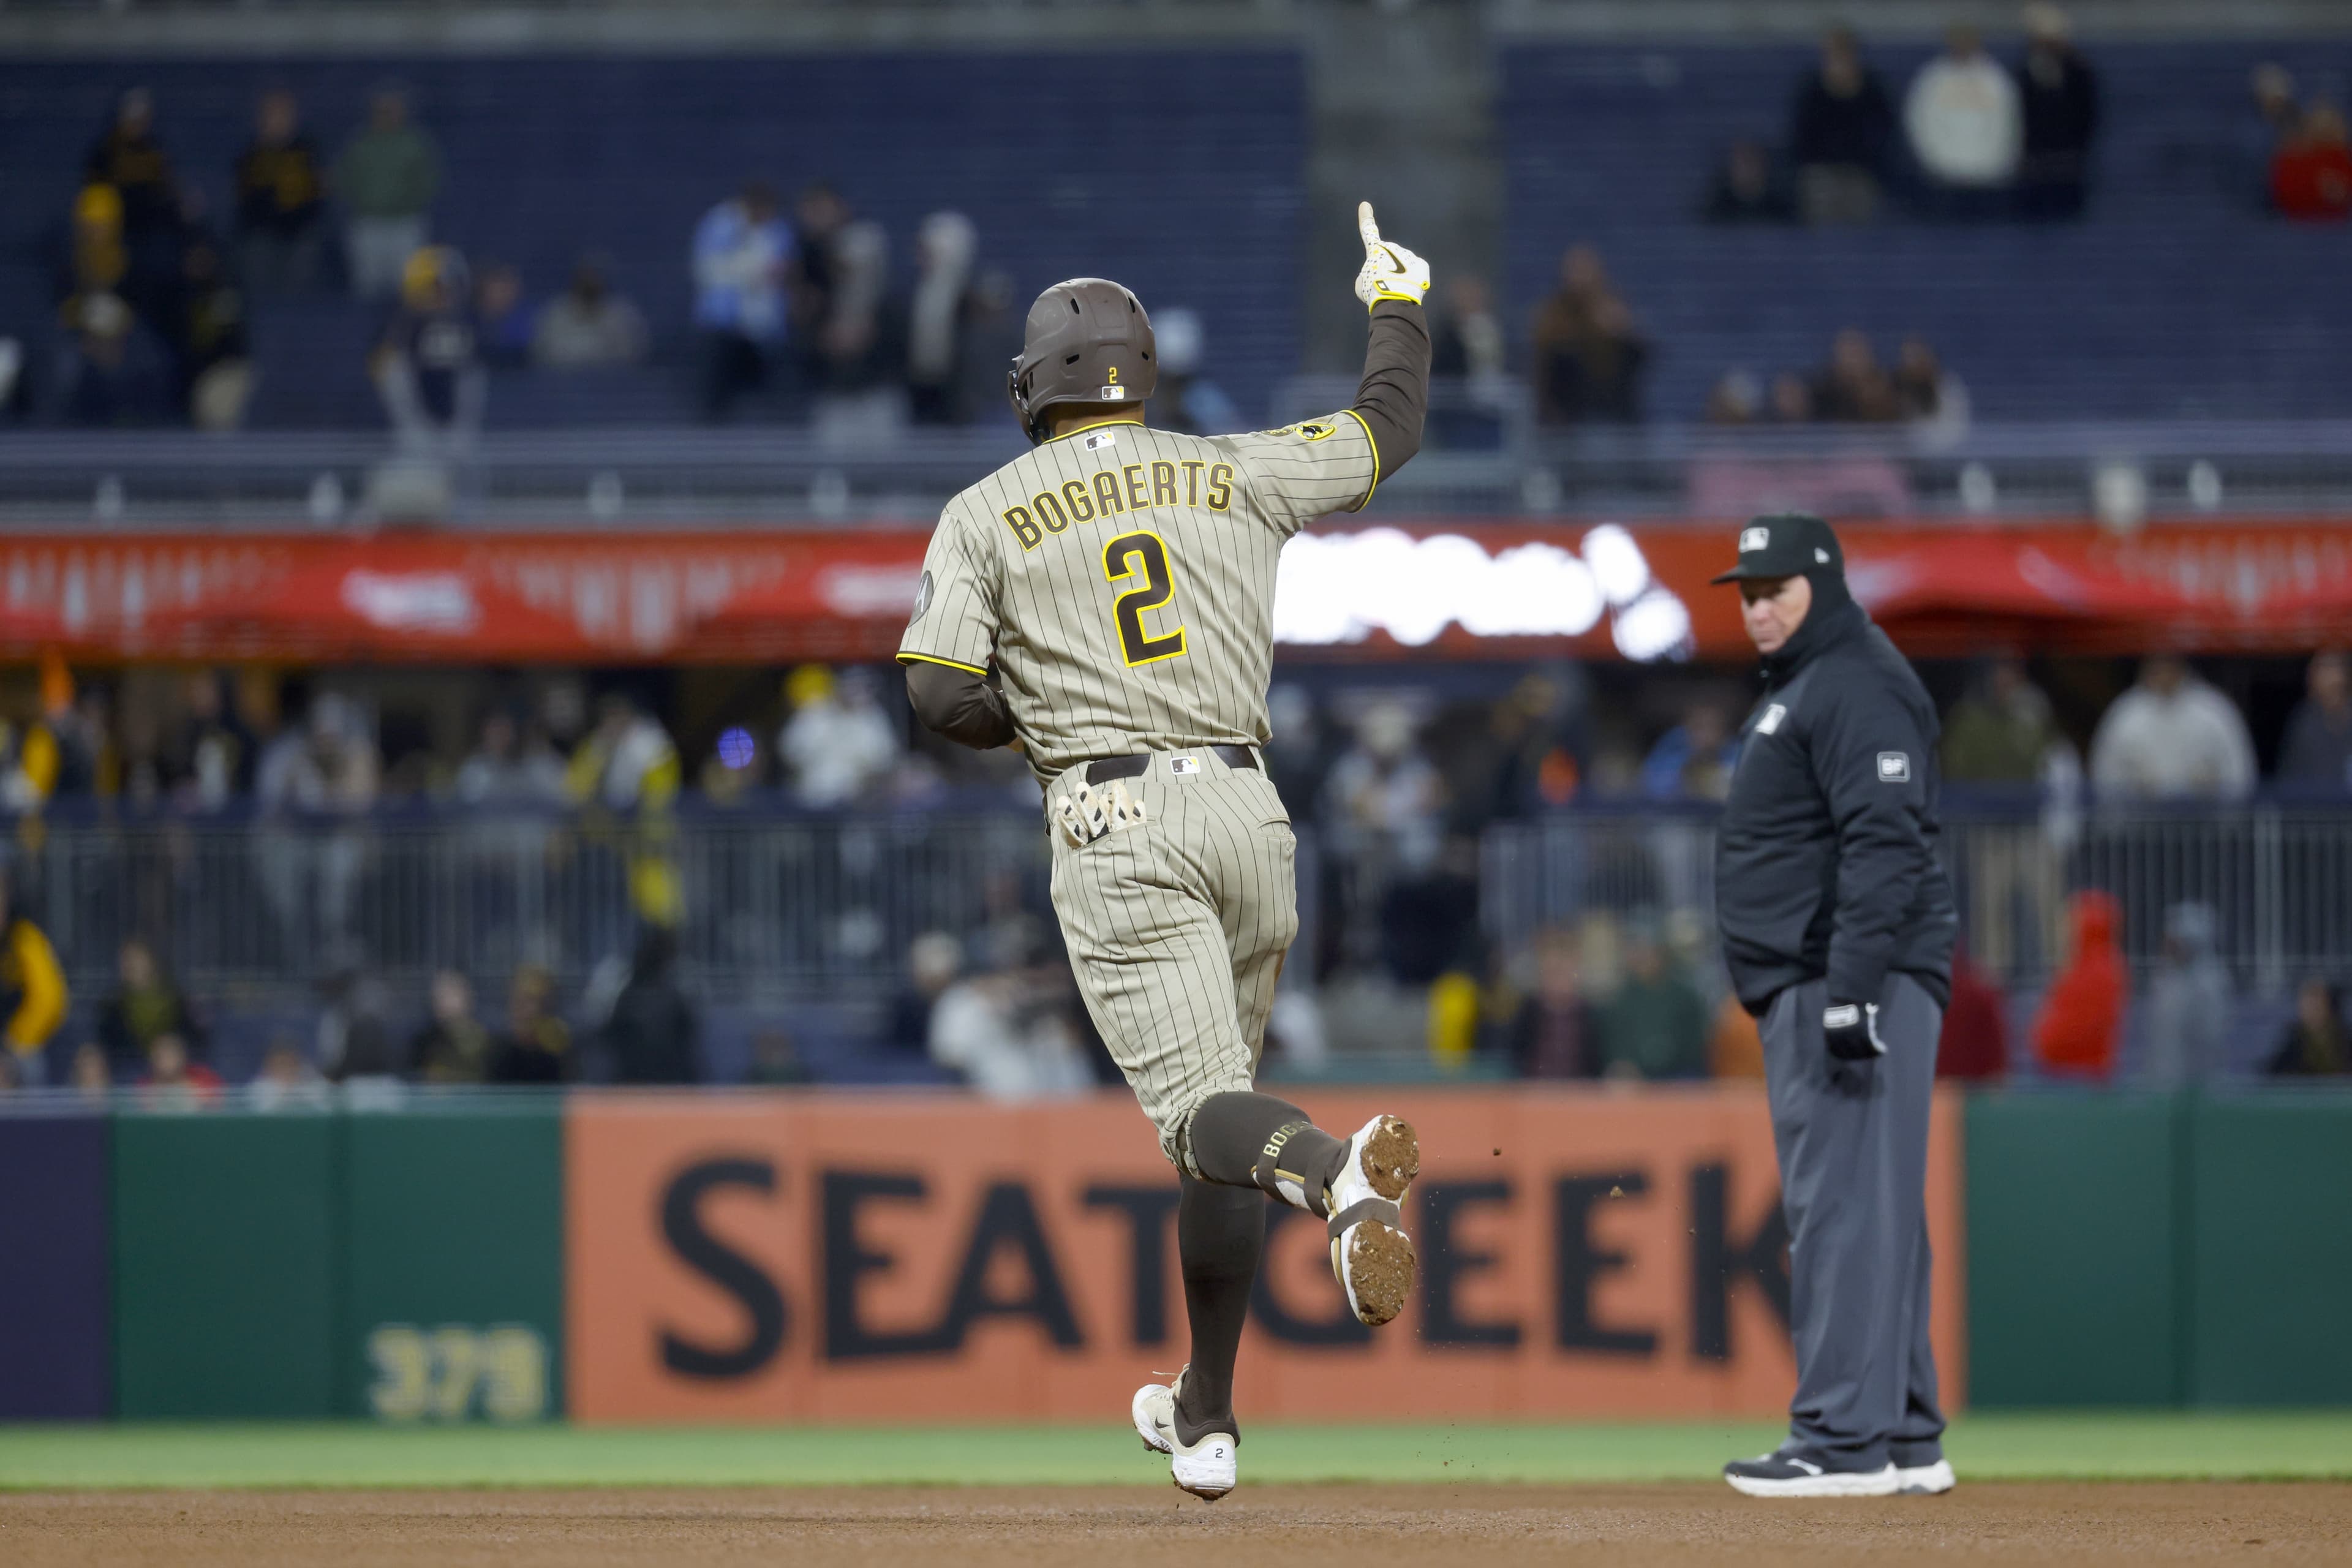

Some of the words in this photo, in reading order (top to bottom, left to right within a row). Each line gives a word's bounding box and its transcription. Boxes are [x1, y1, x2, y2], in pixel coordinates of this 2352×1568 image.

[1109, 367, 1117, 384] 2
[1001, 460, 1234, 552] BOGAERTS
[1102, 529, 1187, 668] 2
[1215, 1448, 1224, 1458] 2
